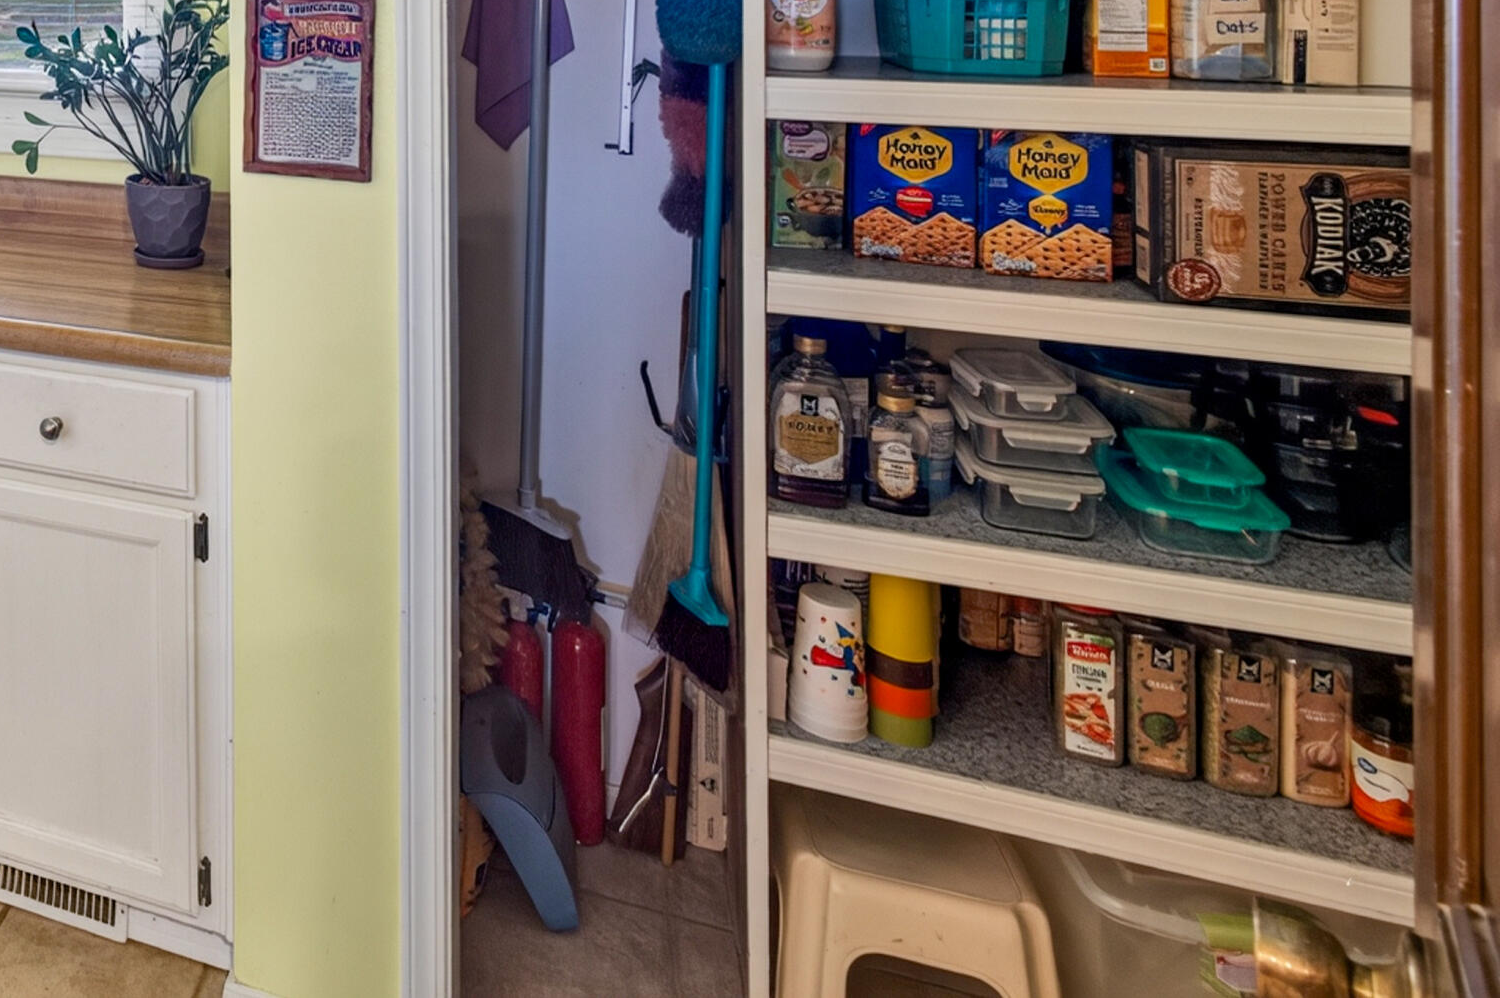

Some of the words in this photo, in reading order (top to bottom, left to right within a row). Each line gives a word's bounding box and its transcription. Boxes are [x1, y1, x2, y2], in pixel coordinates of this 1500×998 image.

[885, 138, 947, 159] Honey
[1017, 148, 1081, 167] Honey
[890, 155, 938, 171] Maid
[1021, 163, 1072, 180] Maid
[1311, 196, 1344, 276] KODIAK
